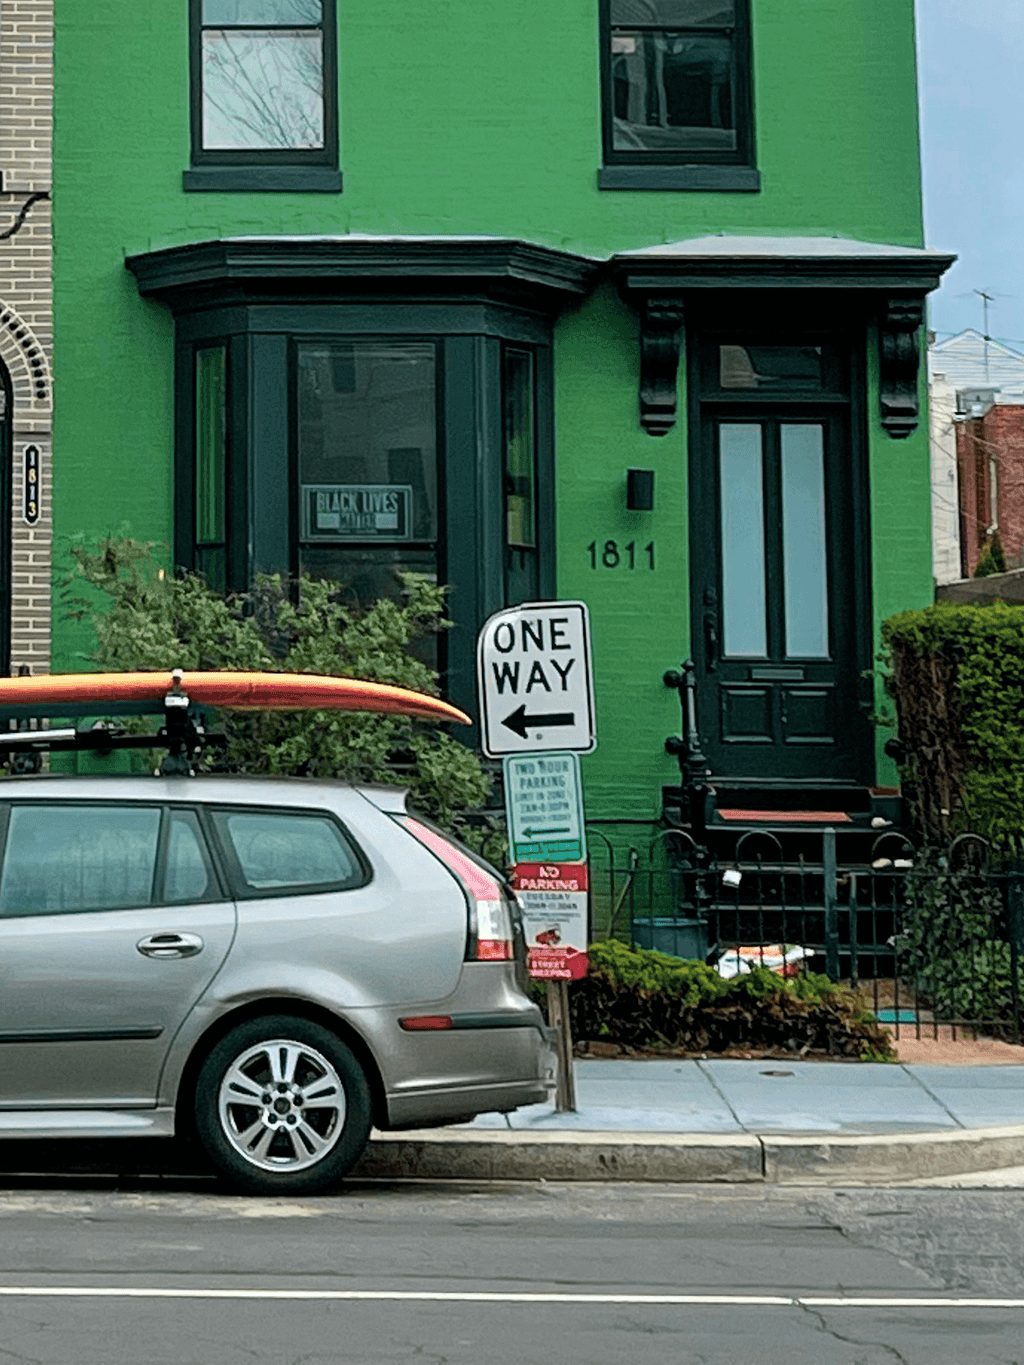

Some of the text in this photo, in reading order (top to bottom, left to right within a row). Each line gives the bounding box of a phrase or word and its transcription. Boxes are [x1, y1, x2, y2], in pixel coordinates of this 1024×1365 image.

[28, 450, 37, 517] 1813
[317, 491, 398, 513] BLACK LIVES
[587, 539, 655, 570] 1811
[493, 618, 571, 653] ONE
[492, 658, 576, 694] WAY
[514, 760, 569, 775] TWO HOUR
[519, 775, 566, 789] PARKING
[539, 866, 560, 878] NO
[520, 878, 579, 890] PARKING
